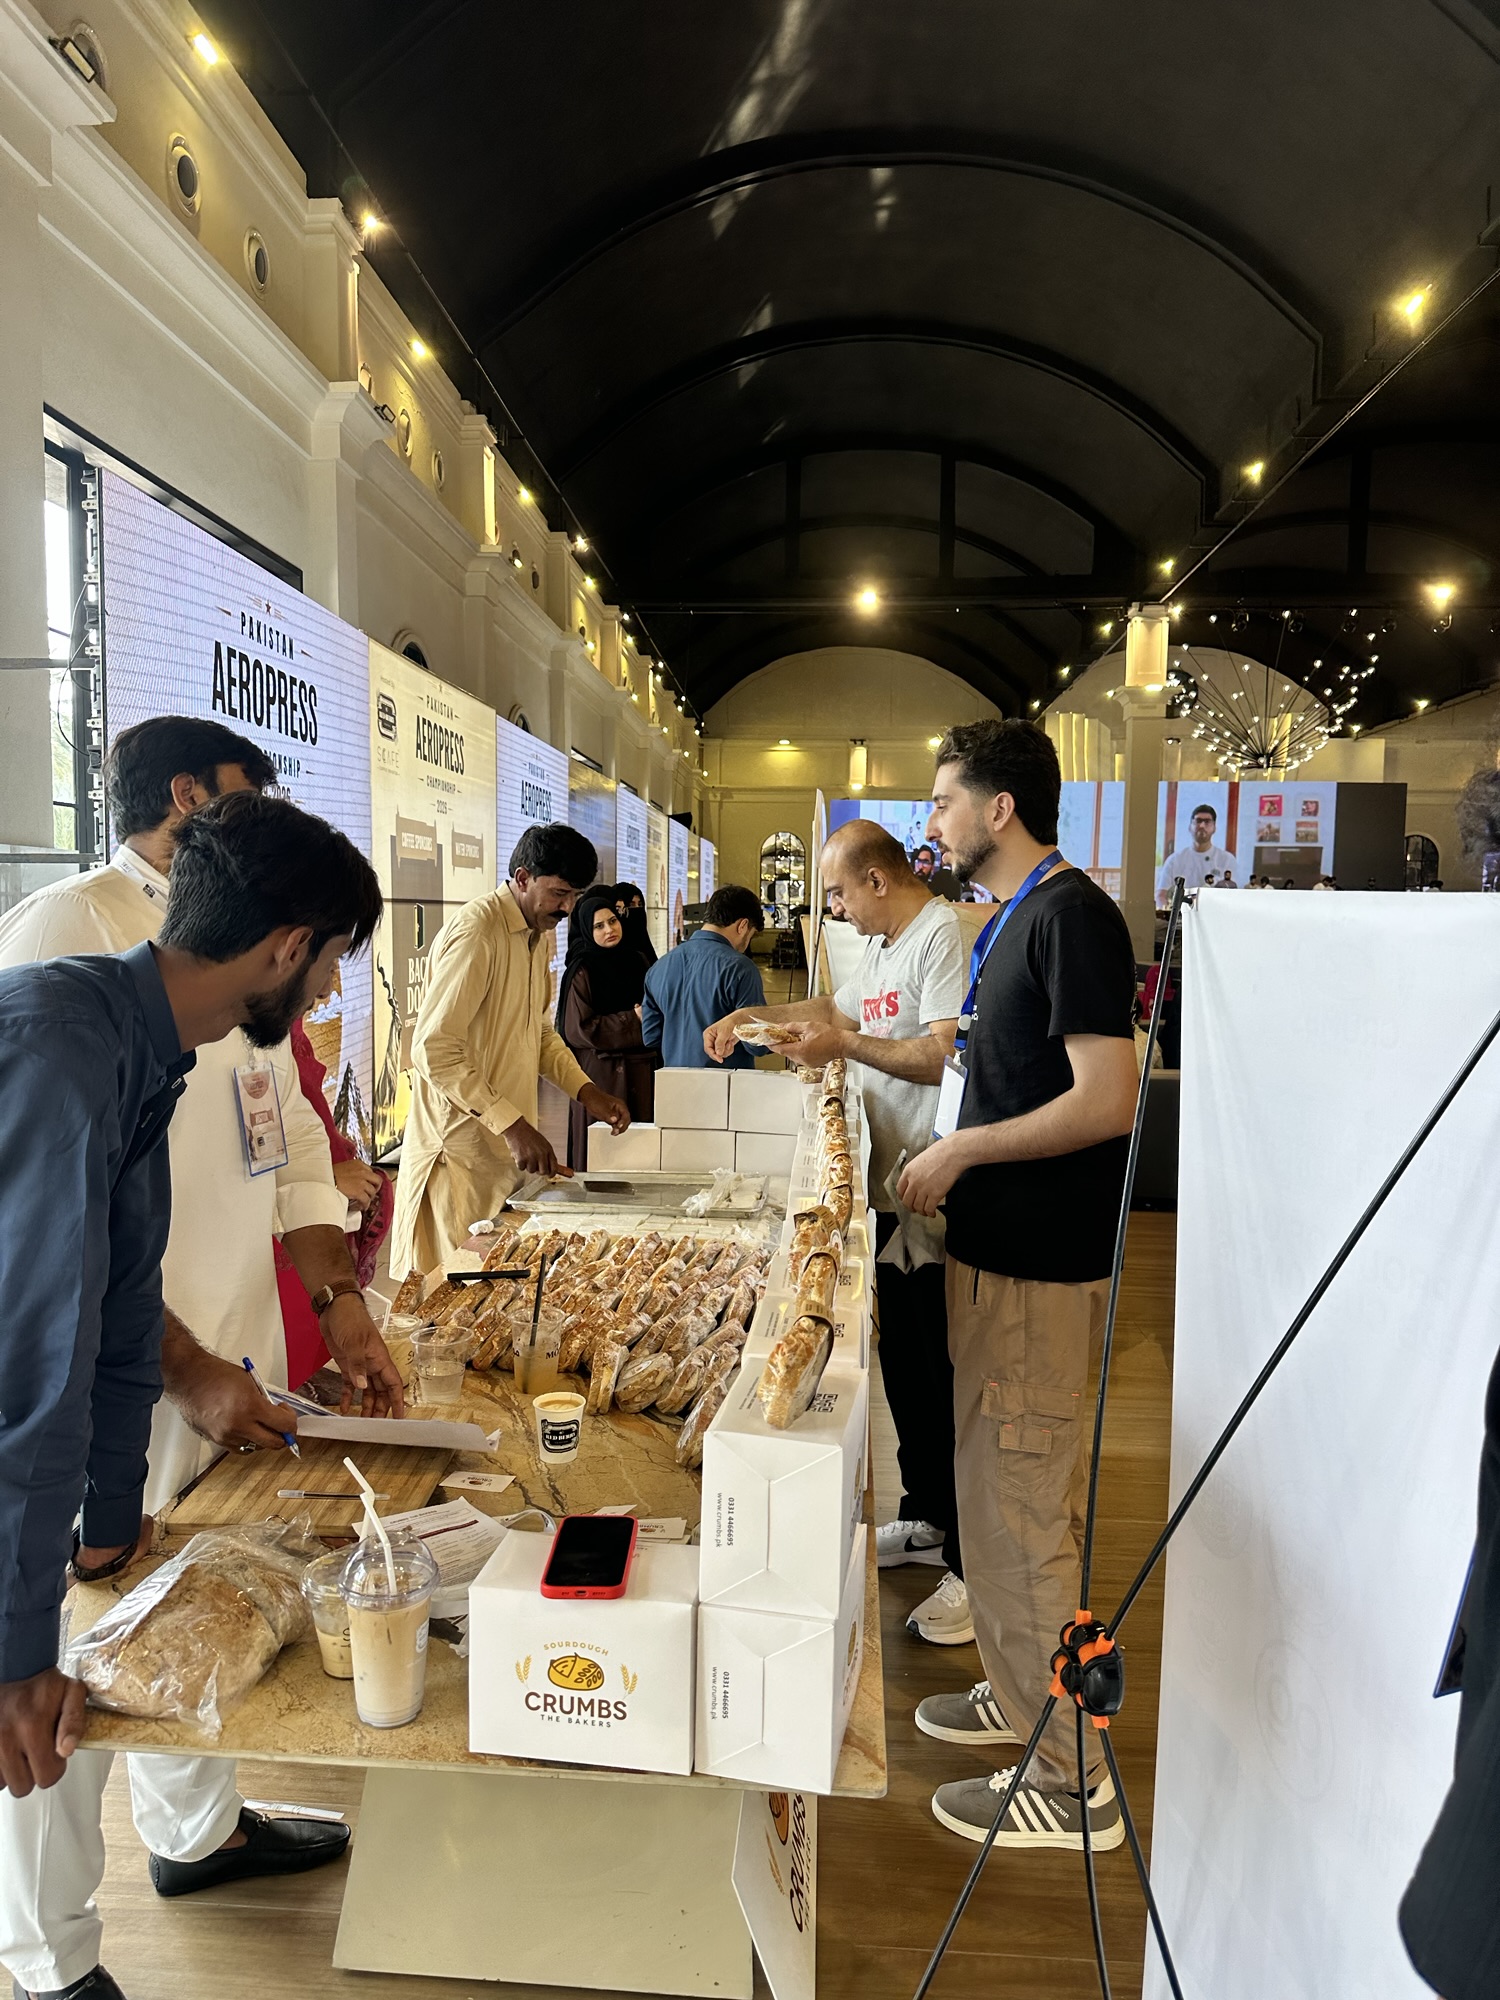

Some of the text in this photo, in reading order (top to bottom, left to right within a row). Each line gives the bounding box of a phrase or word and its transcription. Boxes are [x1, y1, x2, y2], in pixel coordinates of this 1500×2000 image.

[241, 611, 294, 660] PAKISTAN
[212, 640, 317, 746] AEROPRESS
[427, 695, 453, 720] PAKISTAN
[416, 715, 464, 775] AEROPRESS
[521, 780, 552, 823] AEROPRESS
[408, 957, 427, 984] BAC
[714, 1492, 723, 1548] www.crumbs.pk
[726, 1497, 735, 1546] 0331 4466695
[543, 1641, 610, 1656] SOURDOUGH
[525, 1691, 628, 1721] CRUMBS
[709, 1666, 718, 1720] www.crumbs.pk
[721, 1671, 730, 1719] 0331 4466695
[540, 1714, 612, 1728] THE BAKERS
[790, 1793, 806, 1933] CRUMBS
